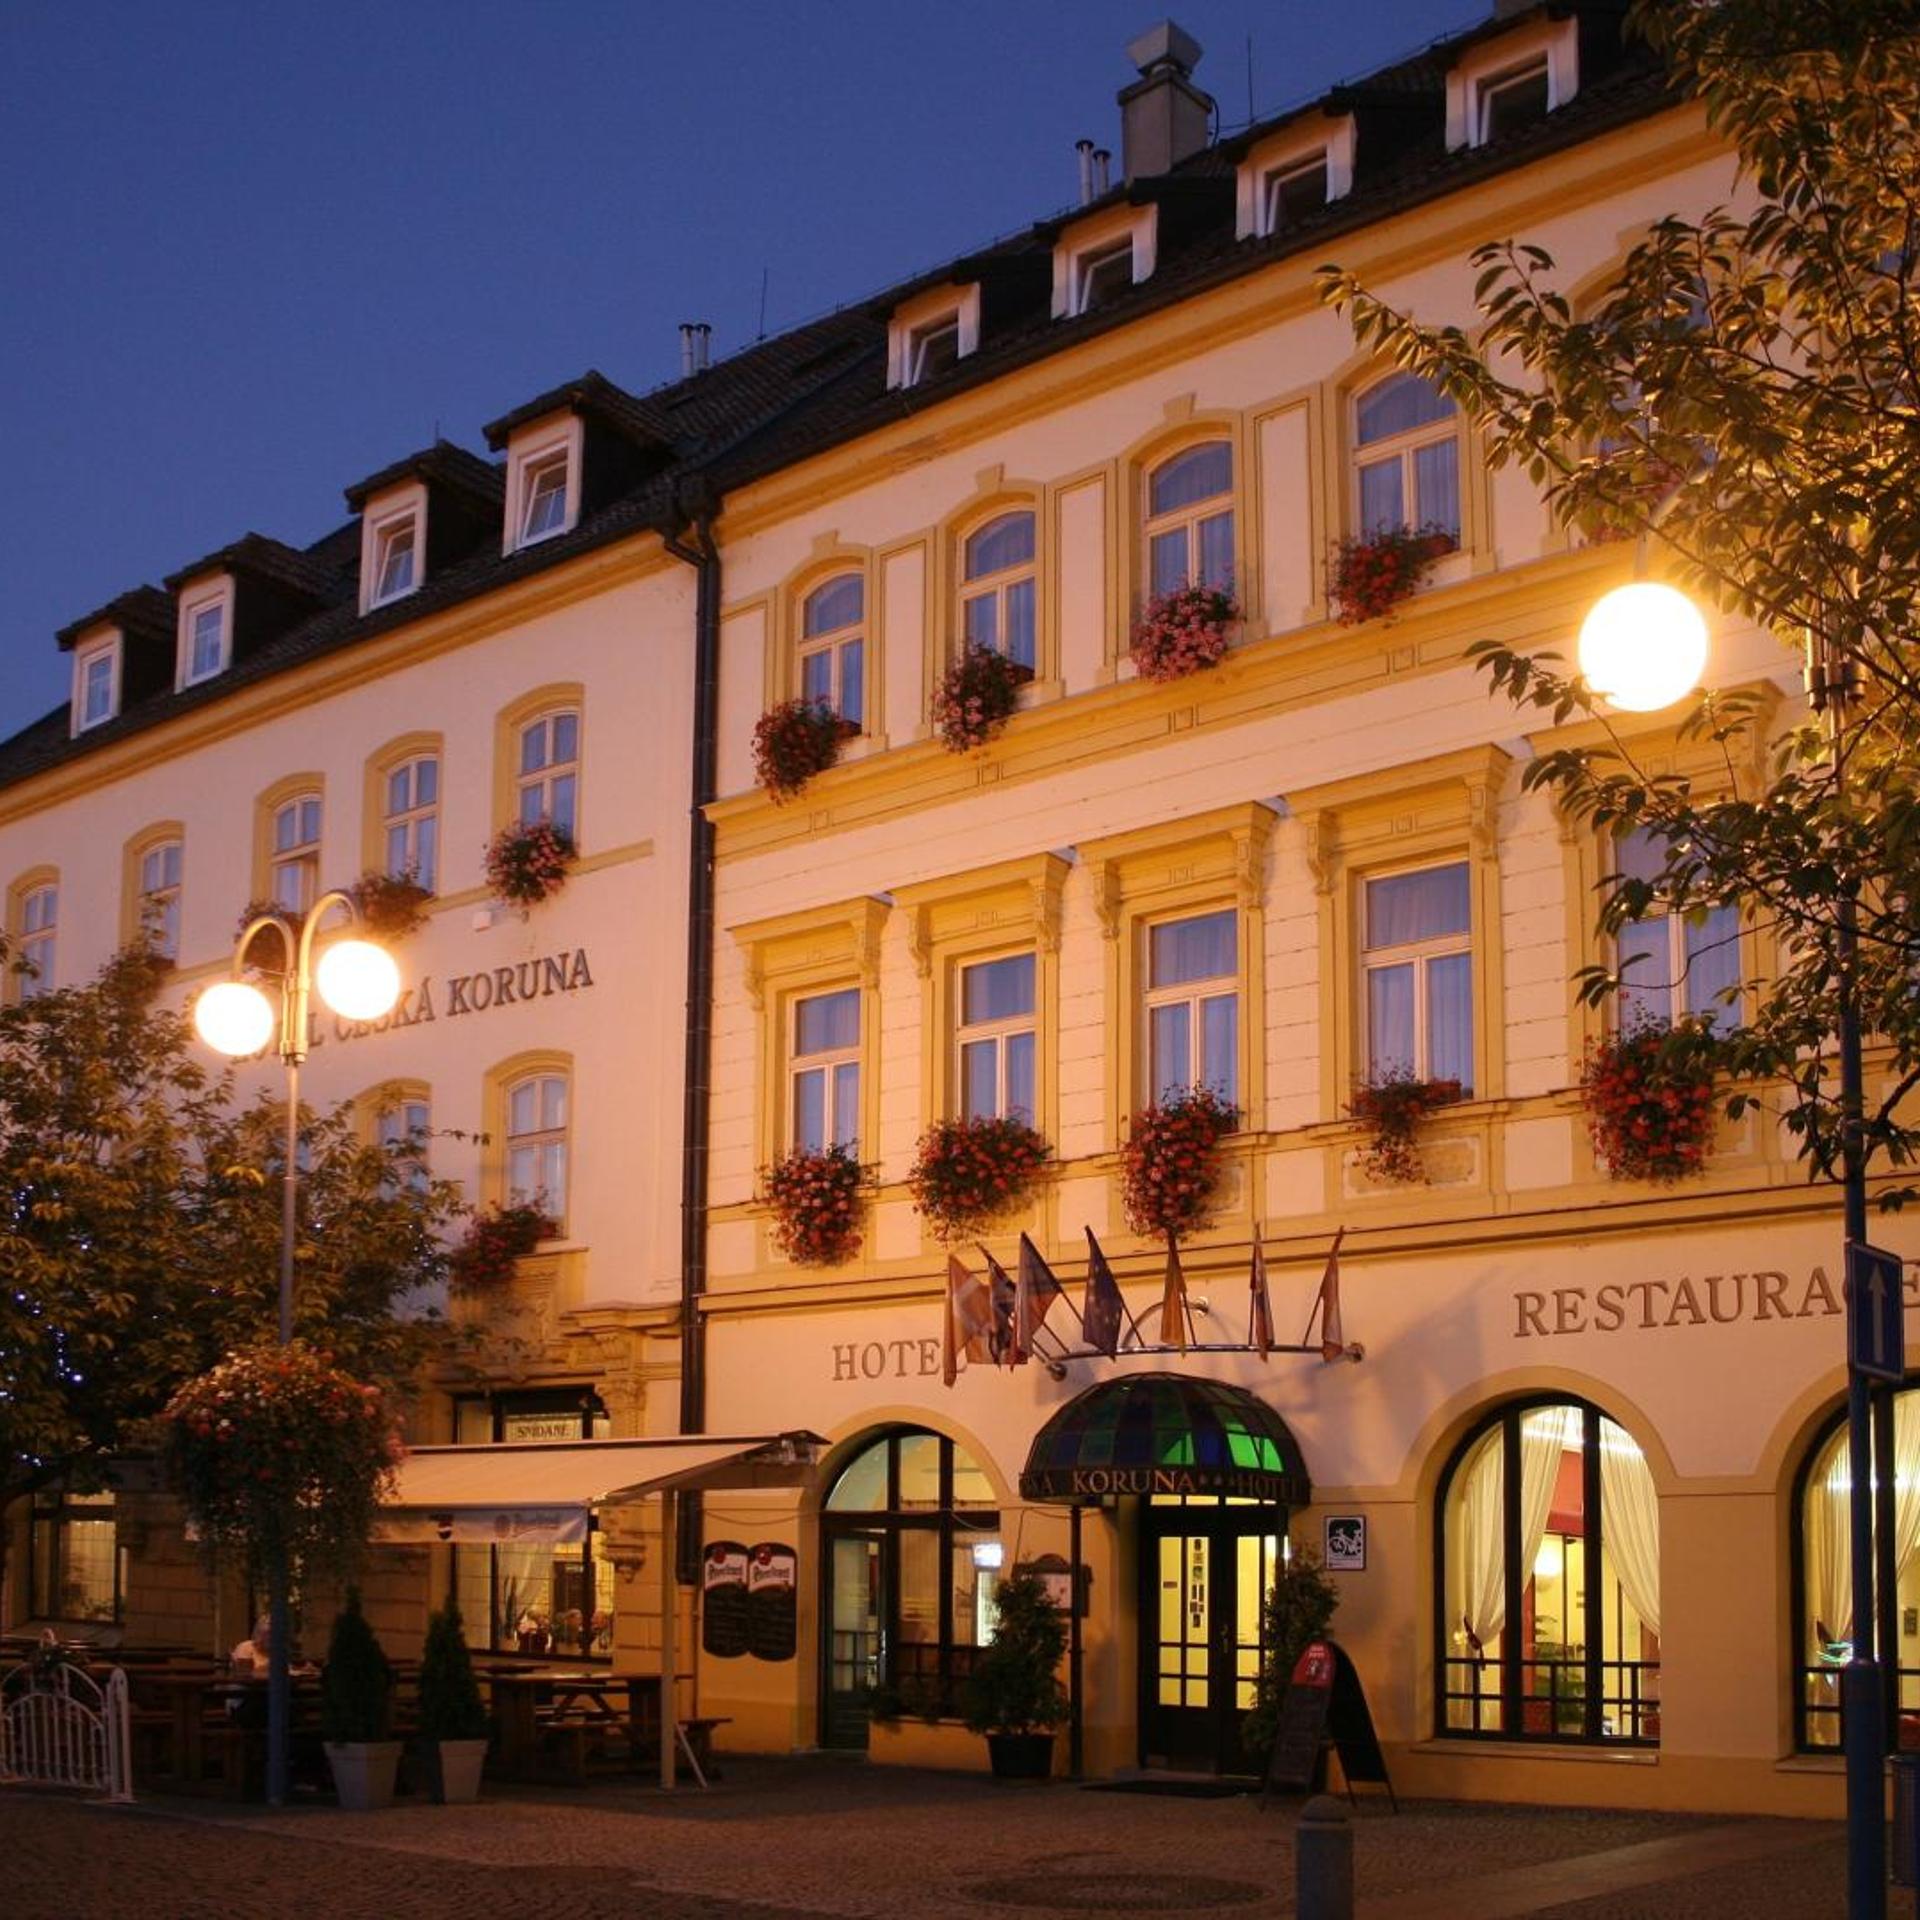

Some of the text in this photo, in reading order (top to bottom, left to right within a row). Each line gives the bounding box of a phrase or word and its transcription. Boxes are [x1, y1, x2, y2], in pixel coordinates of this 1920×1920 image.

[446, 948, 593, 1017] KORUNA
[1513, 1258, 1920, 1338] RESTAURA
[1073, 1469, 1195, 1495] KORUNA
